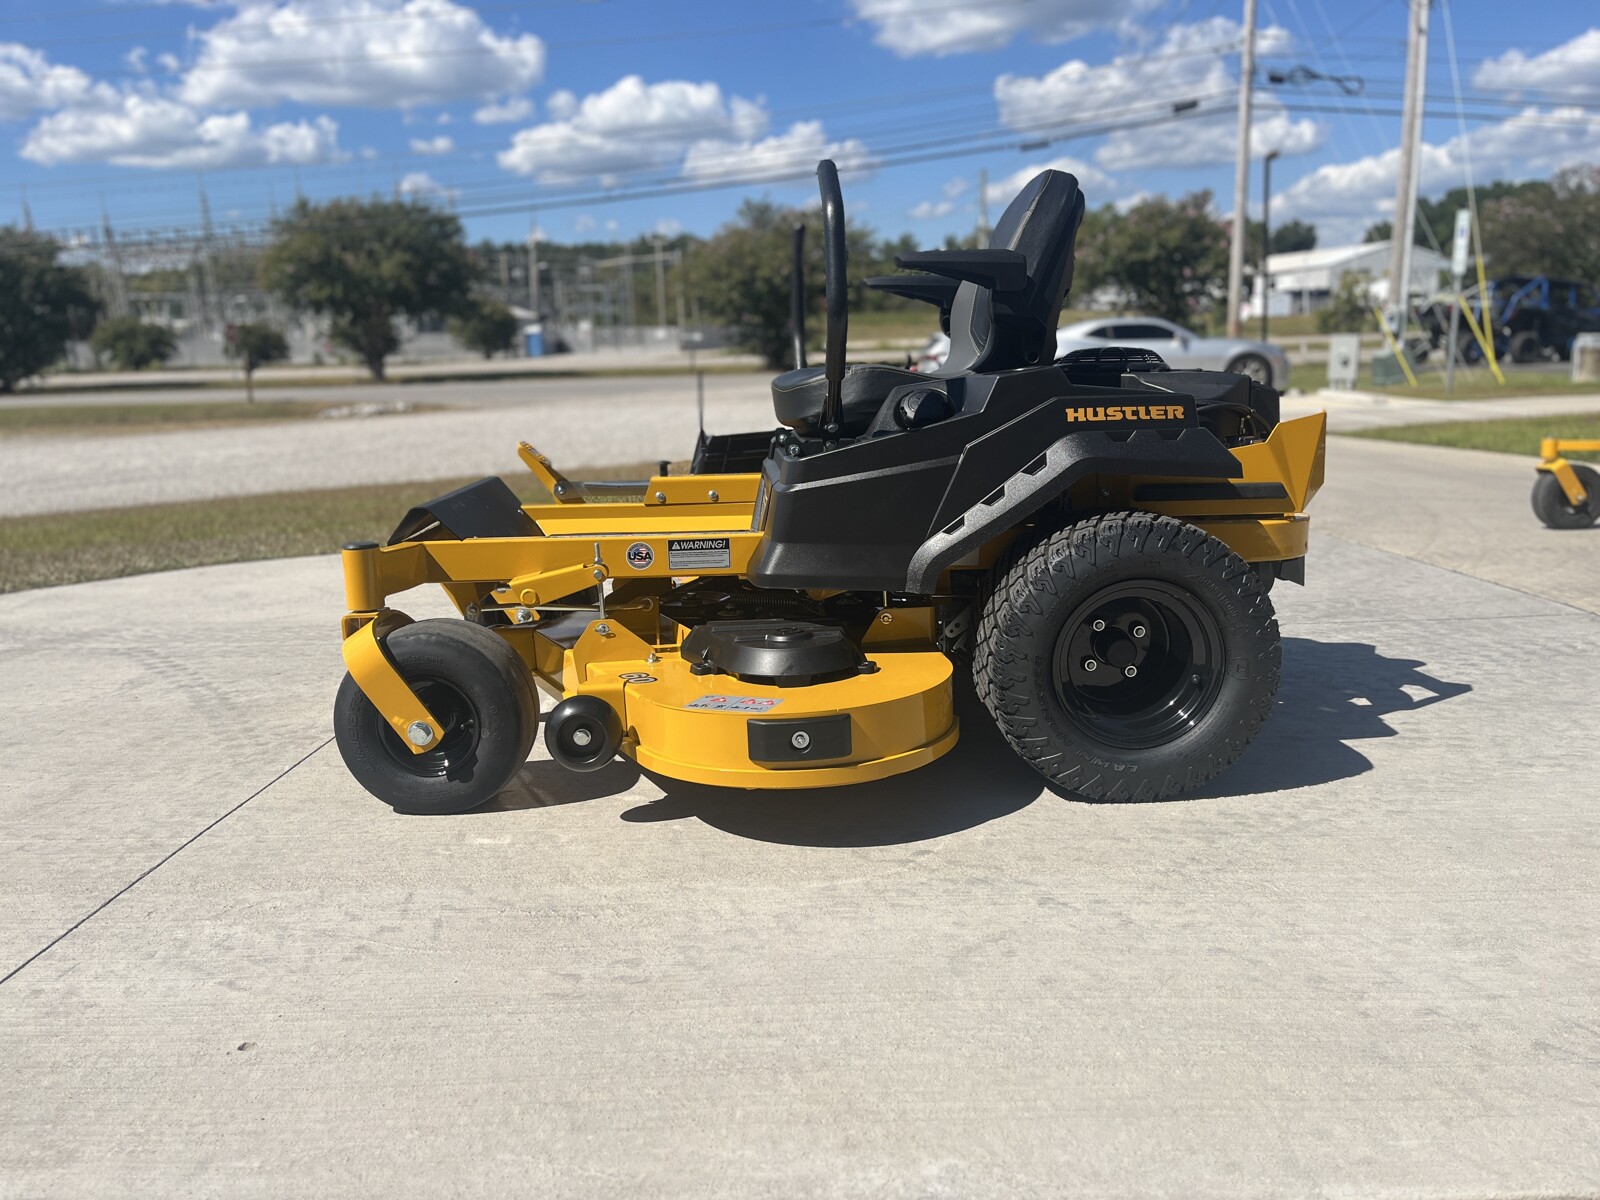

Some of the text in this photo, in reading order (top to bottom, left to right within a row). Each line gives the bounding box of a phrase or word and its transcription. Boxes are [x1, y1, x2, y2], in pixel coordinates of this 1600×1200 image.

[1065, 405, 1185, 423] HUSTLER
[680, 540, 726, 550] WARNING!
[628, 551, 653, 561] USA
